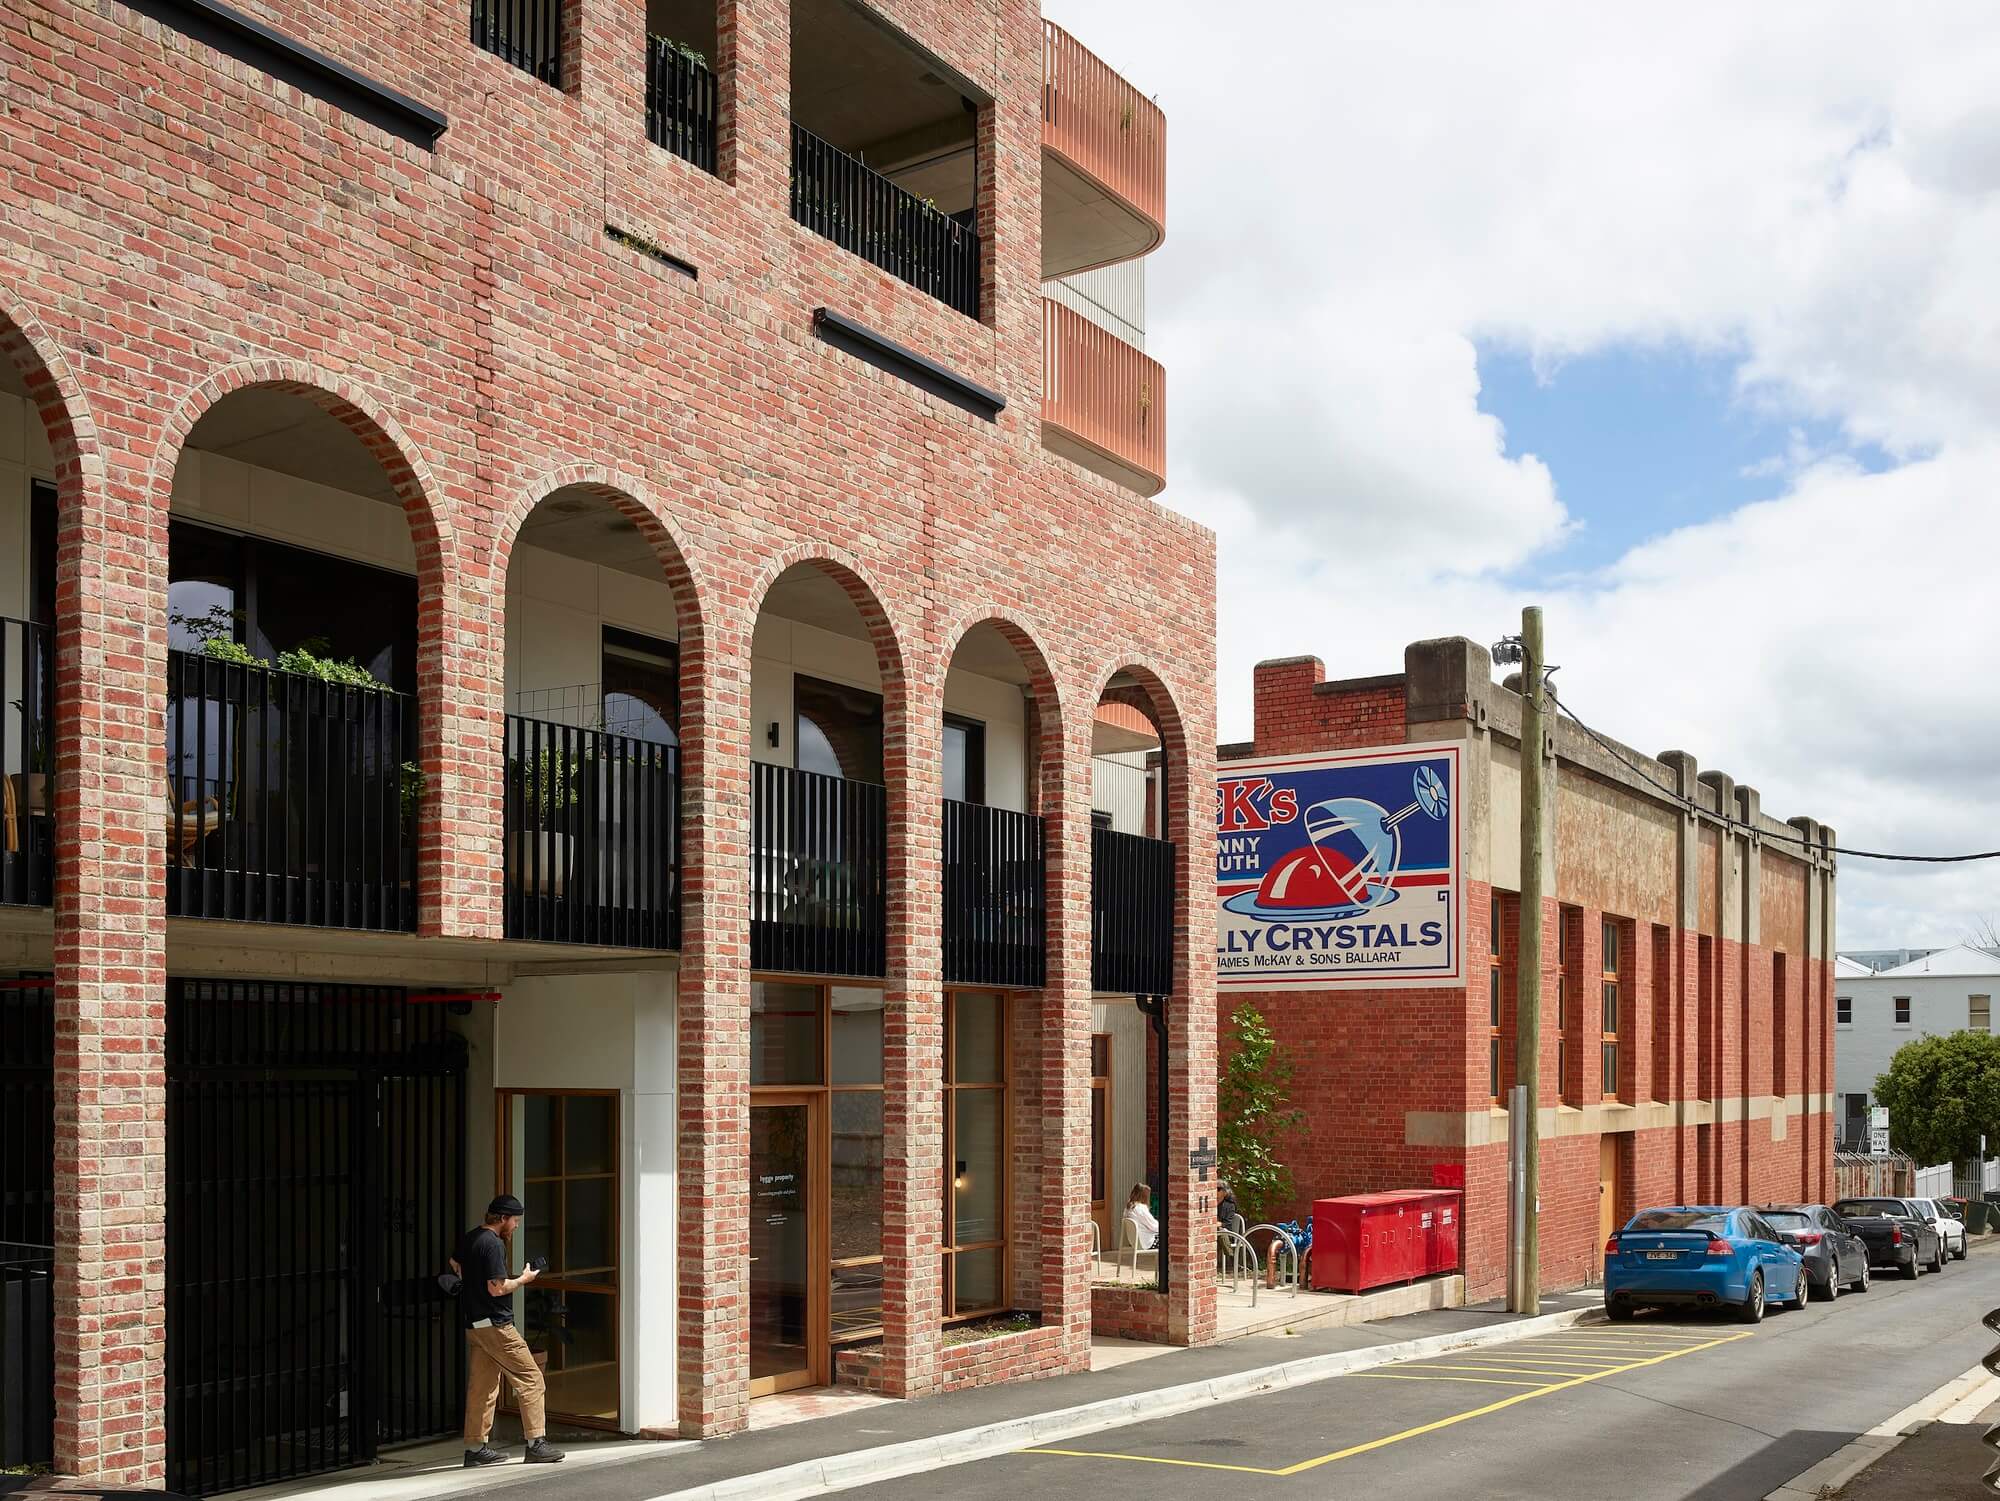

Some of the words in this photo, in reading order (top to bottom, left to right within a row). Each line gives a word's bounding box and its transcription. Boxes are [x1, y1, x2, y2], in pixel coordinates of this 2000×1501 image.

[1219, 854, 1260, 871] UTH
[1266, 921, 1442, 952] CRYSTALS
[1254, 954, 1291, 967] McKAY
[1295, 955, 1305, 966] &
[1310, 952, 1341, 965] SONS
[1345, 951, 1401, 964] BALLARAT
